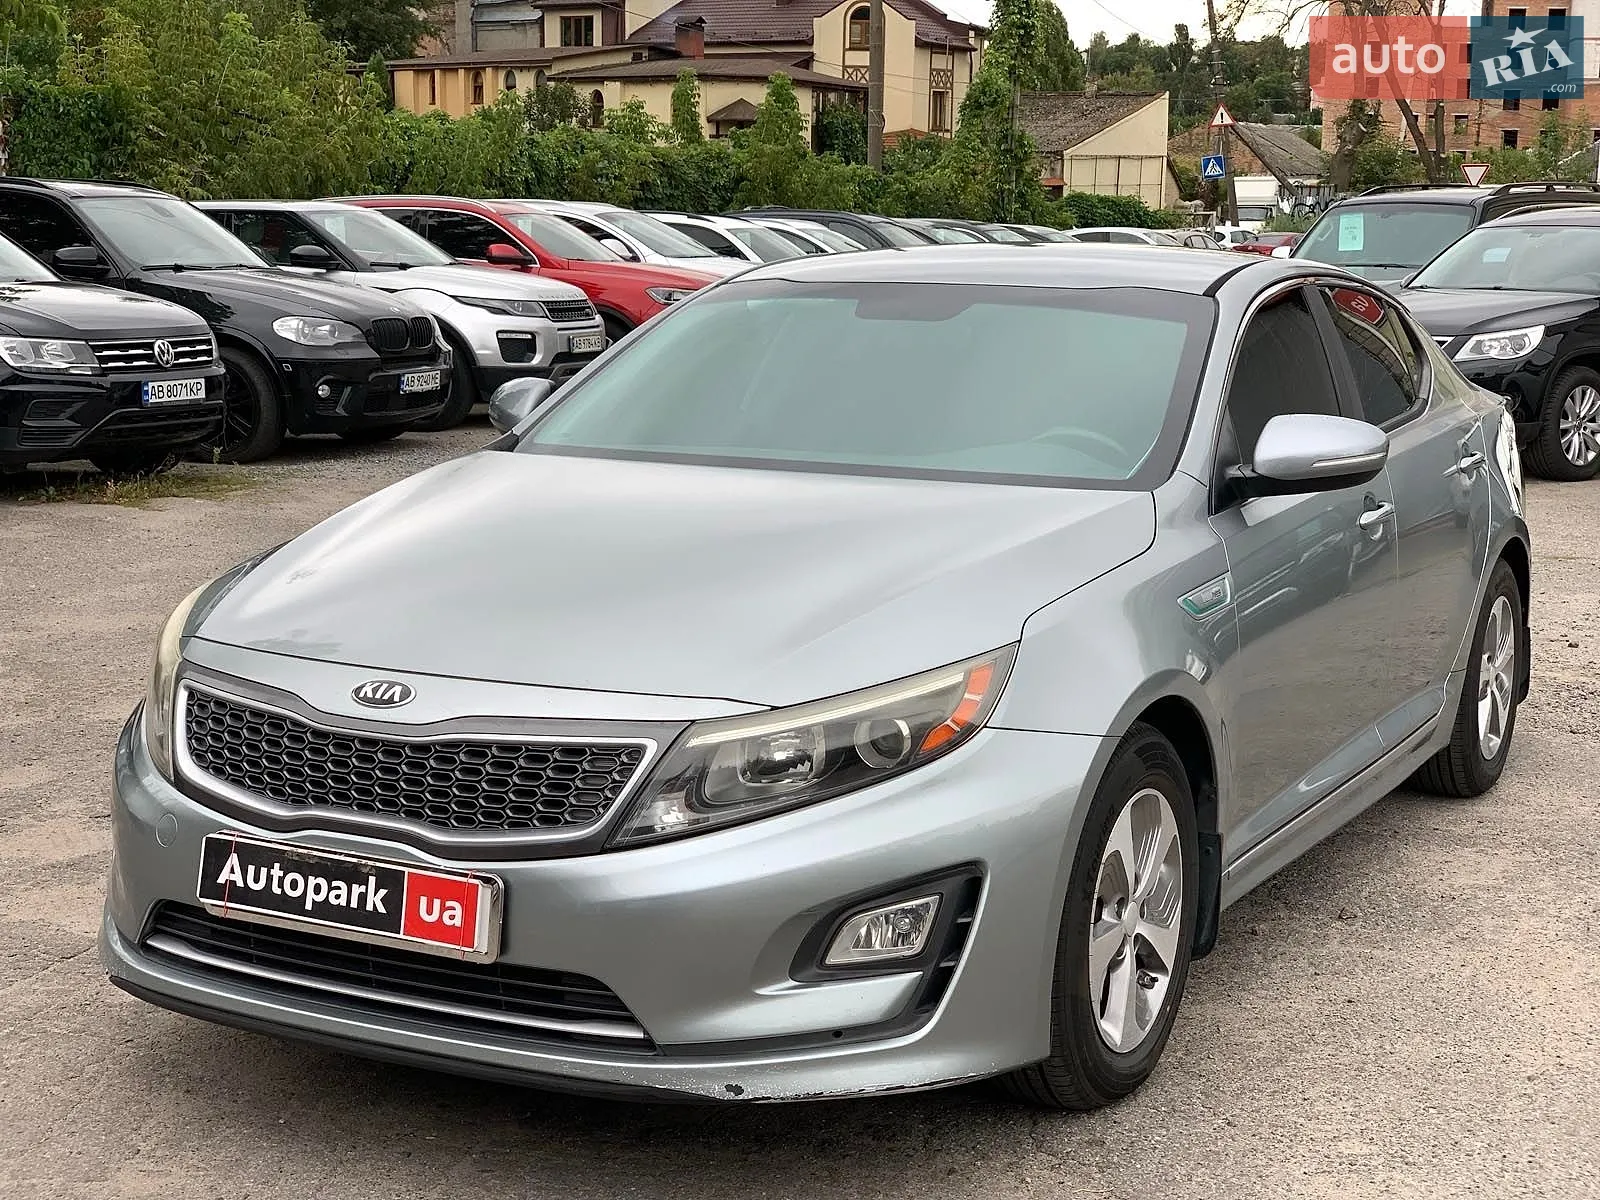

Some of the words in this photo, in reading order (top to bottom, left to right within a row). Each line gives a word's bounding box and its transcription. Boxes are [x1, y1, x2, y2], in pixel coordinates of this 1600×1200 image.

[405, 375, 416, 389] AB
[150, 384, 165, 400] AB
[358, 682, 403, 702] KIA
[216, 852, 391, 914] Autopark
[418, 894, 463, 928] ua
